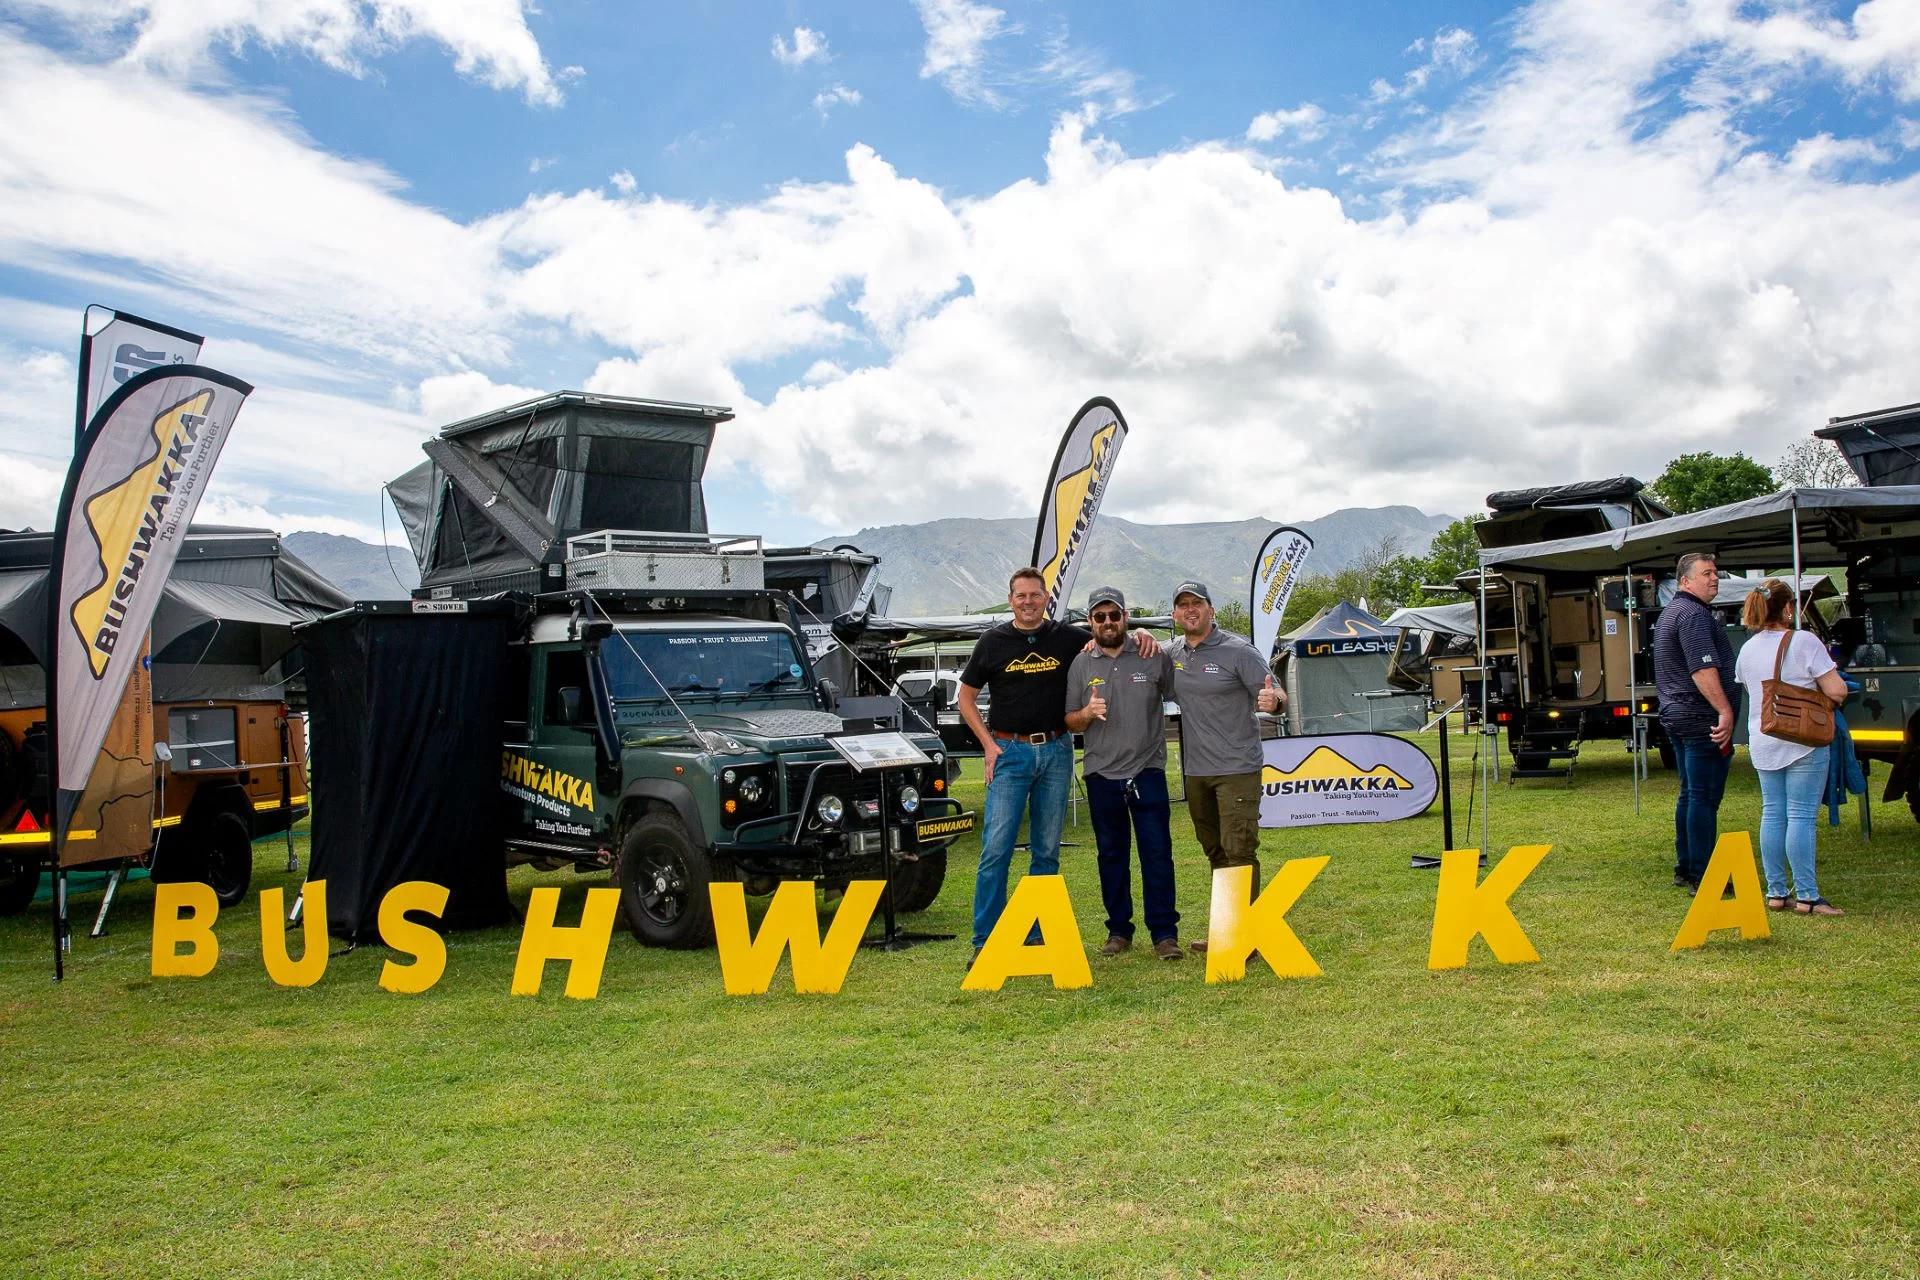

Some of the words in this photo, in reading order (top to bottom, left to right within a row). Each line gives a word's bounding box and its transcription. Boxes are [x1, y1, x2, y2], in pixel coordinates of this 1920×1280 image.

[160, 497, 188, 542] Taking
[180, 471, 198, 497] You
[193, 421, 221, 471] Further
[95, 413, 206, 655] BUSHWAKKA
[1275, 573, 1295, 611] FITMENT
[1292, 543, 1309, 574] CENTRE
[668, 637, 697, 645] PASSION
[730, 635, 769, 643] RELIABILITY
[1010, 661, 1056, 671] BUSHWAKKA
[1324, 793, 1352, 801] Taking
[1352, 792, 1369, 800] You
[1369, 791, 1400, 799] Further
[536, 794, 571, 817] Products
[1290, 812, 1317, 820] Passion
[1345, 809, 1380, 817] Reliability
[535, 819, 556, 834] Taking
[555, 821, 568, 833] You
[567, 823, 592, 836] Further
[917, 817, 973, 836] BUSHWAKKA
